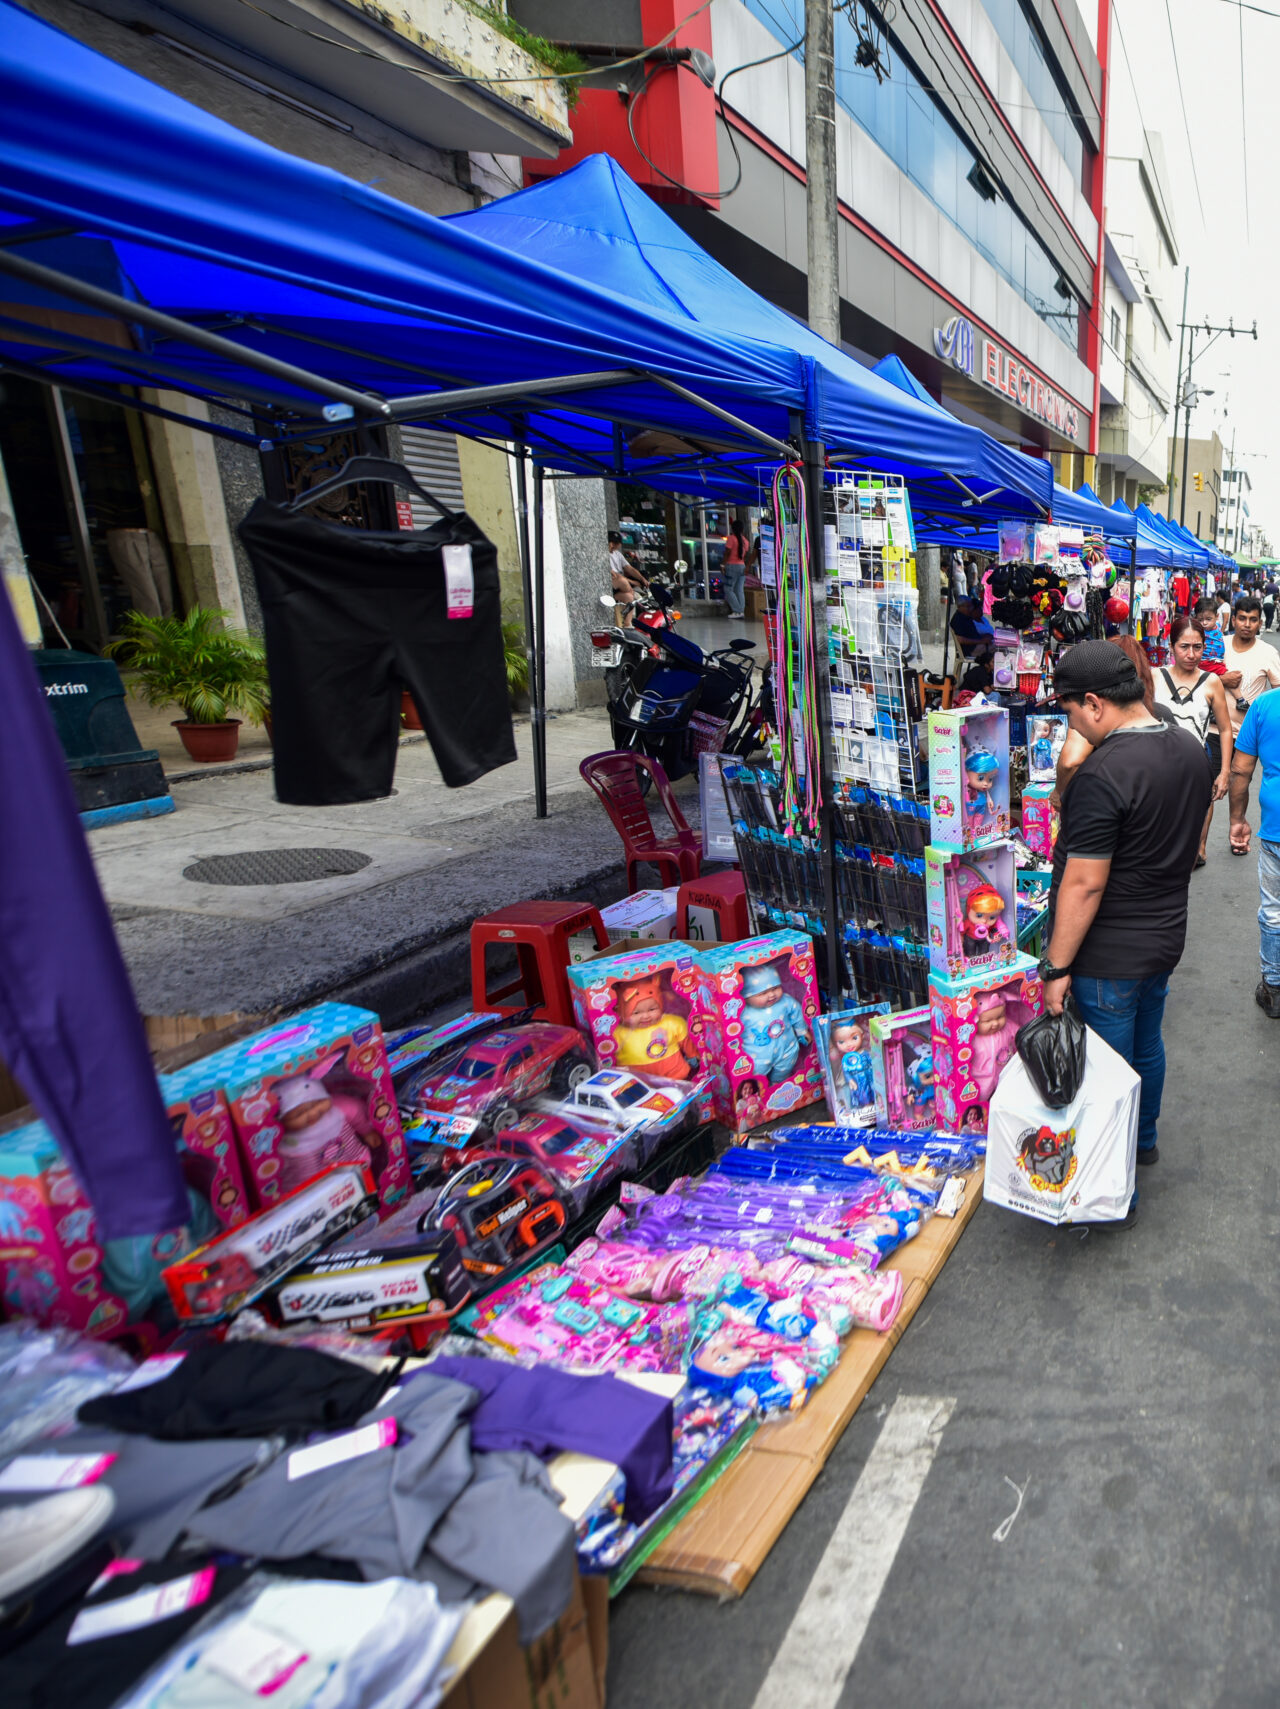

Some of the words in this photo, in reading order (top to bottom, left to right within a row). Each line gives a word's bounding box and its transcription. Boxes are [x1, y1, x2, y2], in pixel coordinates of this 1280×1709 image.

[982, 339, 1079, 439] ELECTRONICS
[44, 682, 89, 696] xtrim
[383, 1284, 419, 1298] TEAM
